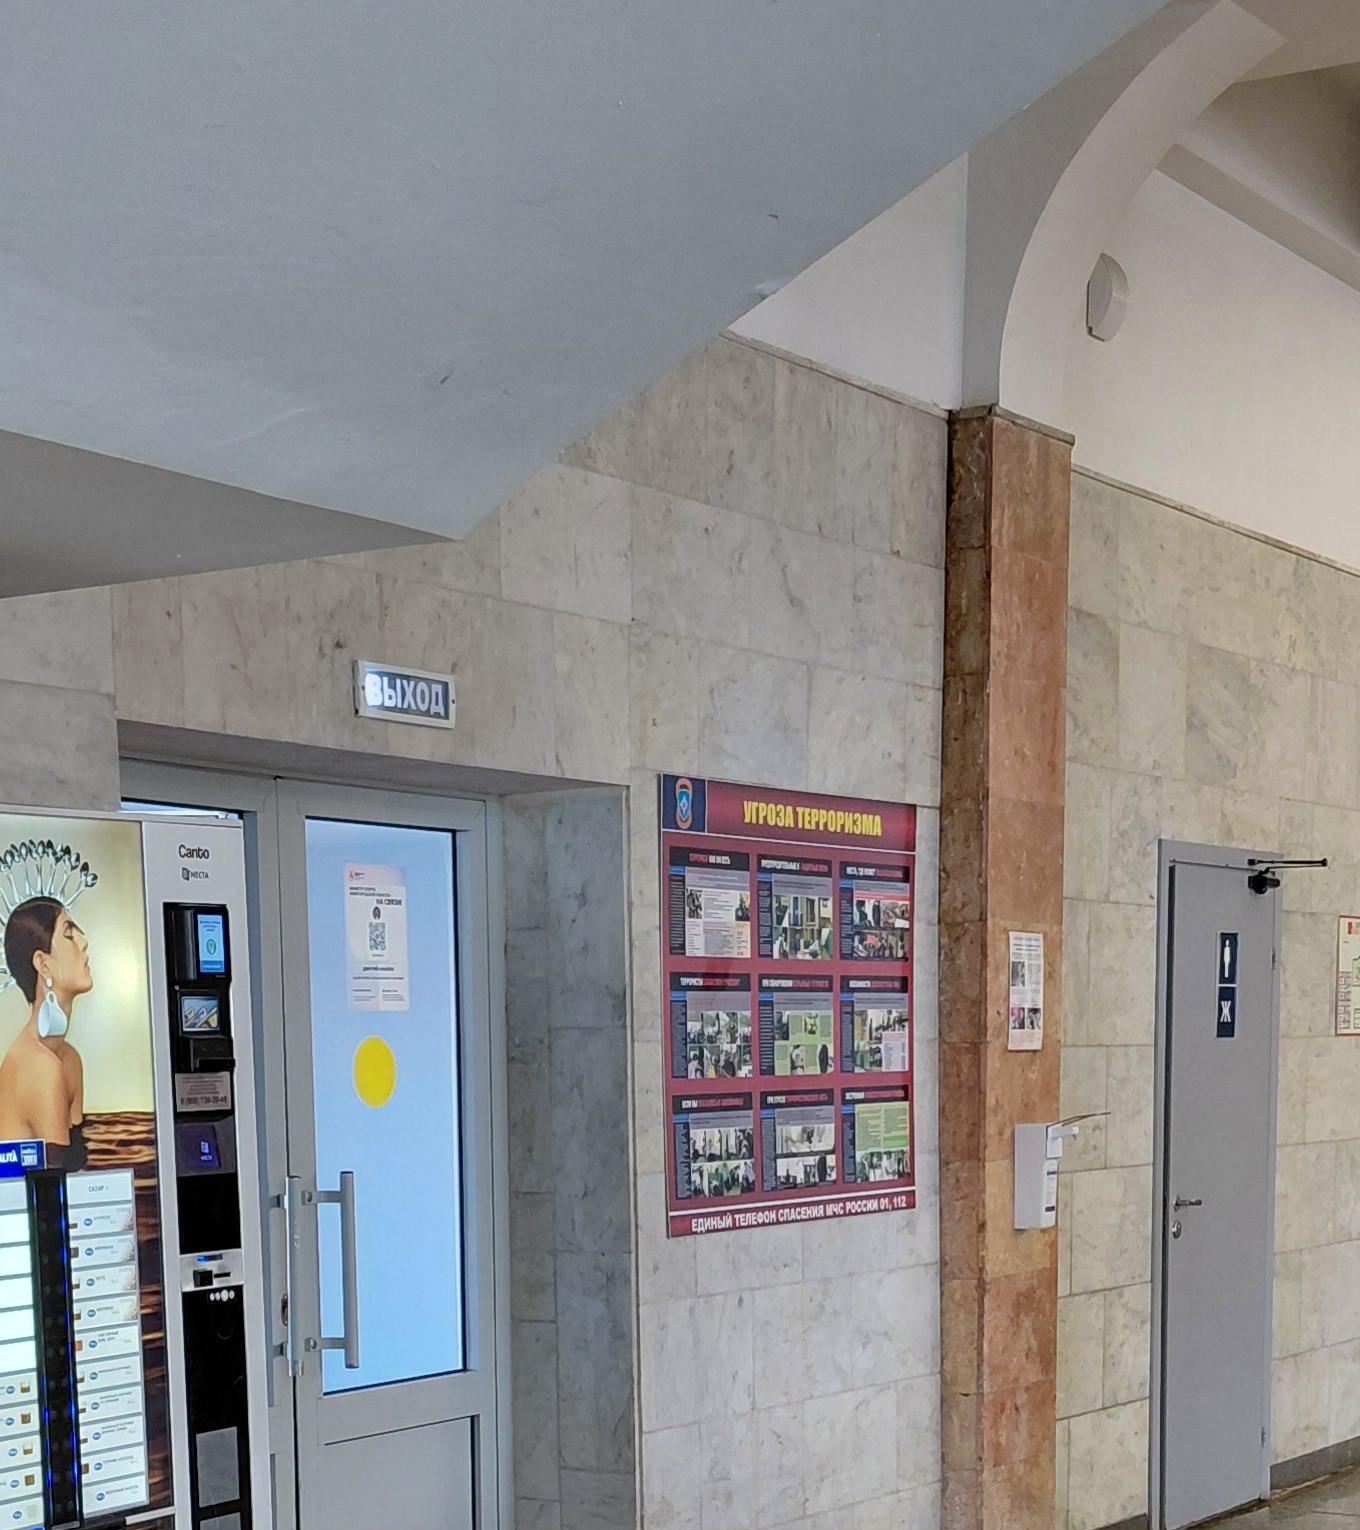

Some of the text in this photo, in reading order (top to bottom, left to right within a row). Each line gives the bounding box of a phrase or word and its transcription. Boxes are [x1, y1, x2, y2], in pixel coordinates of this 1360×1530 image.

[364, 672, 445, 717] ВЫХОД
[742, 800, 882, 837] УГРОЗА ТЕРРОРИЗМА
[178, 843, 210, 859] Canto
[190, 870, 209, 879] NECTA
[1219, 999, 1232, 1023] Ж
[691, 1212, 733, 1234] ЕДИНЫЙ
[735, 1208, 777, 1227] ТЕЛЕФОН
[777, 1203, 824, 1222] СПАСЕНИЯ
[825, 1202, 844, 1217] МЧС
[845, 1198, 879, 1213] РОССИИ
[892, 1195, 907, 1209] 112
